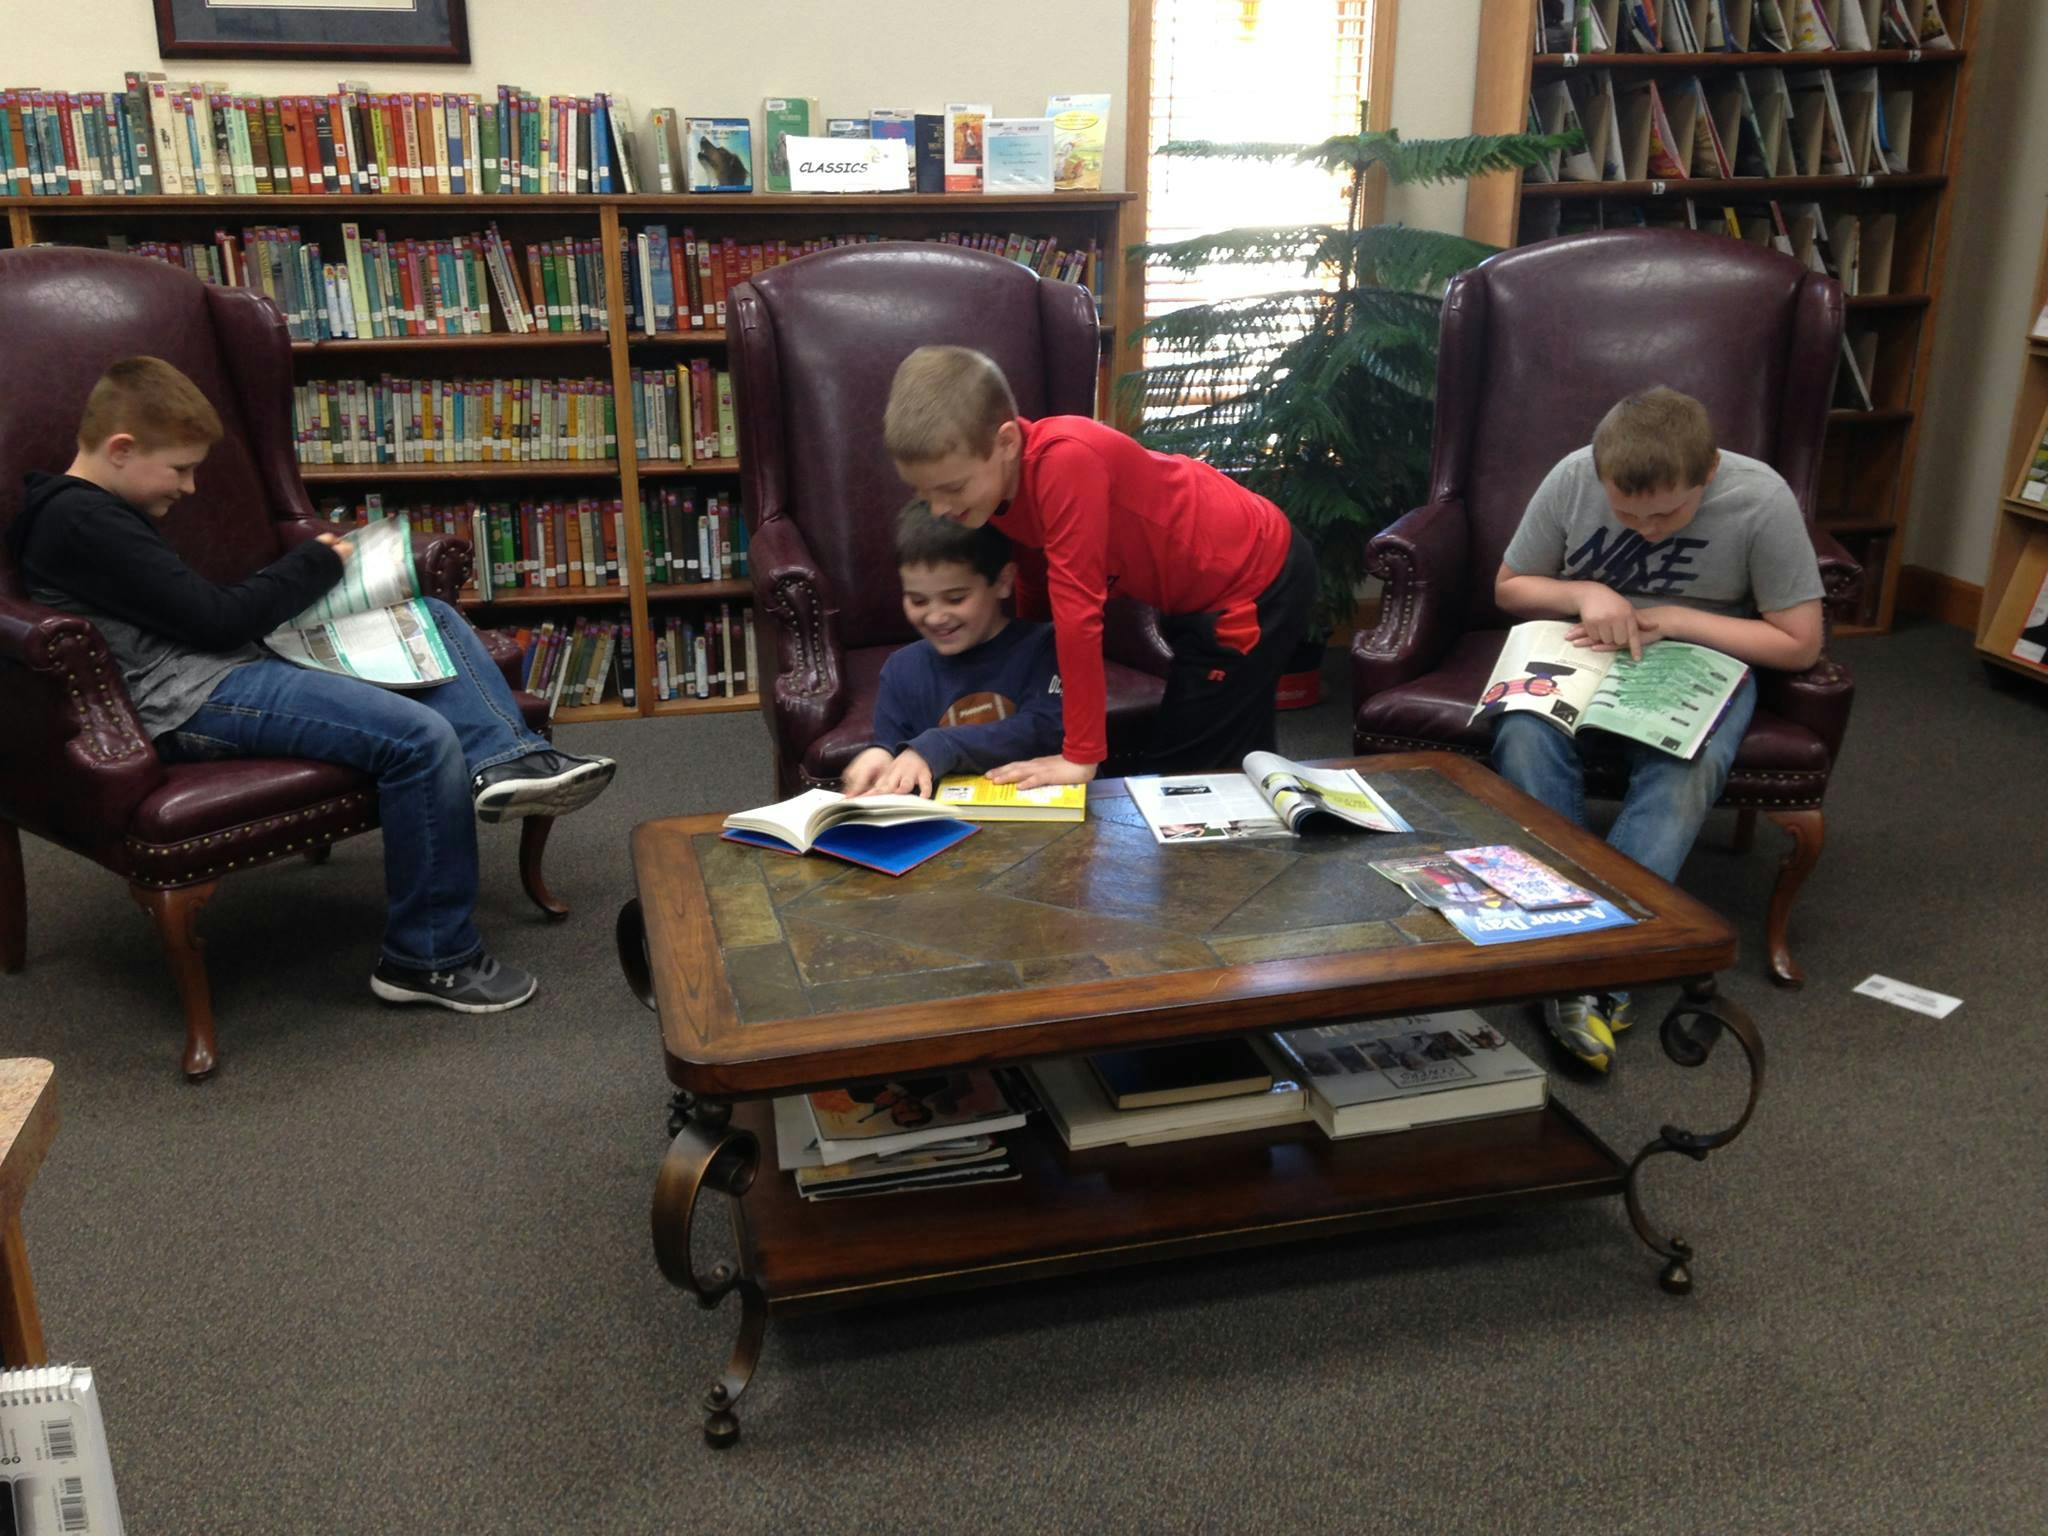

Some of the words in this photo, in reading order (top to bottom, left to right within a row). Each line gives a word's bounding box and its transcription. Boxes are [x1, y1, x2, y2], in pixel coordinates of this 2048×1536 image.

[799, 161, 869, 174] CLASSICS
[1566, 525, 1710, 595] NIKE
[1477, 914, 1530, 931] Day
[1531, 907, 1606, 926] Arbor
